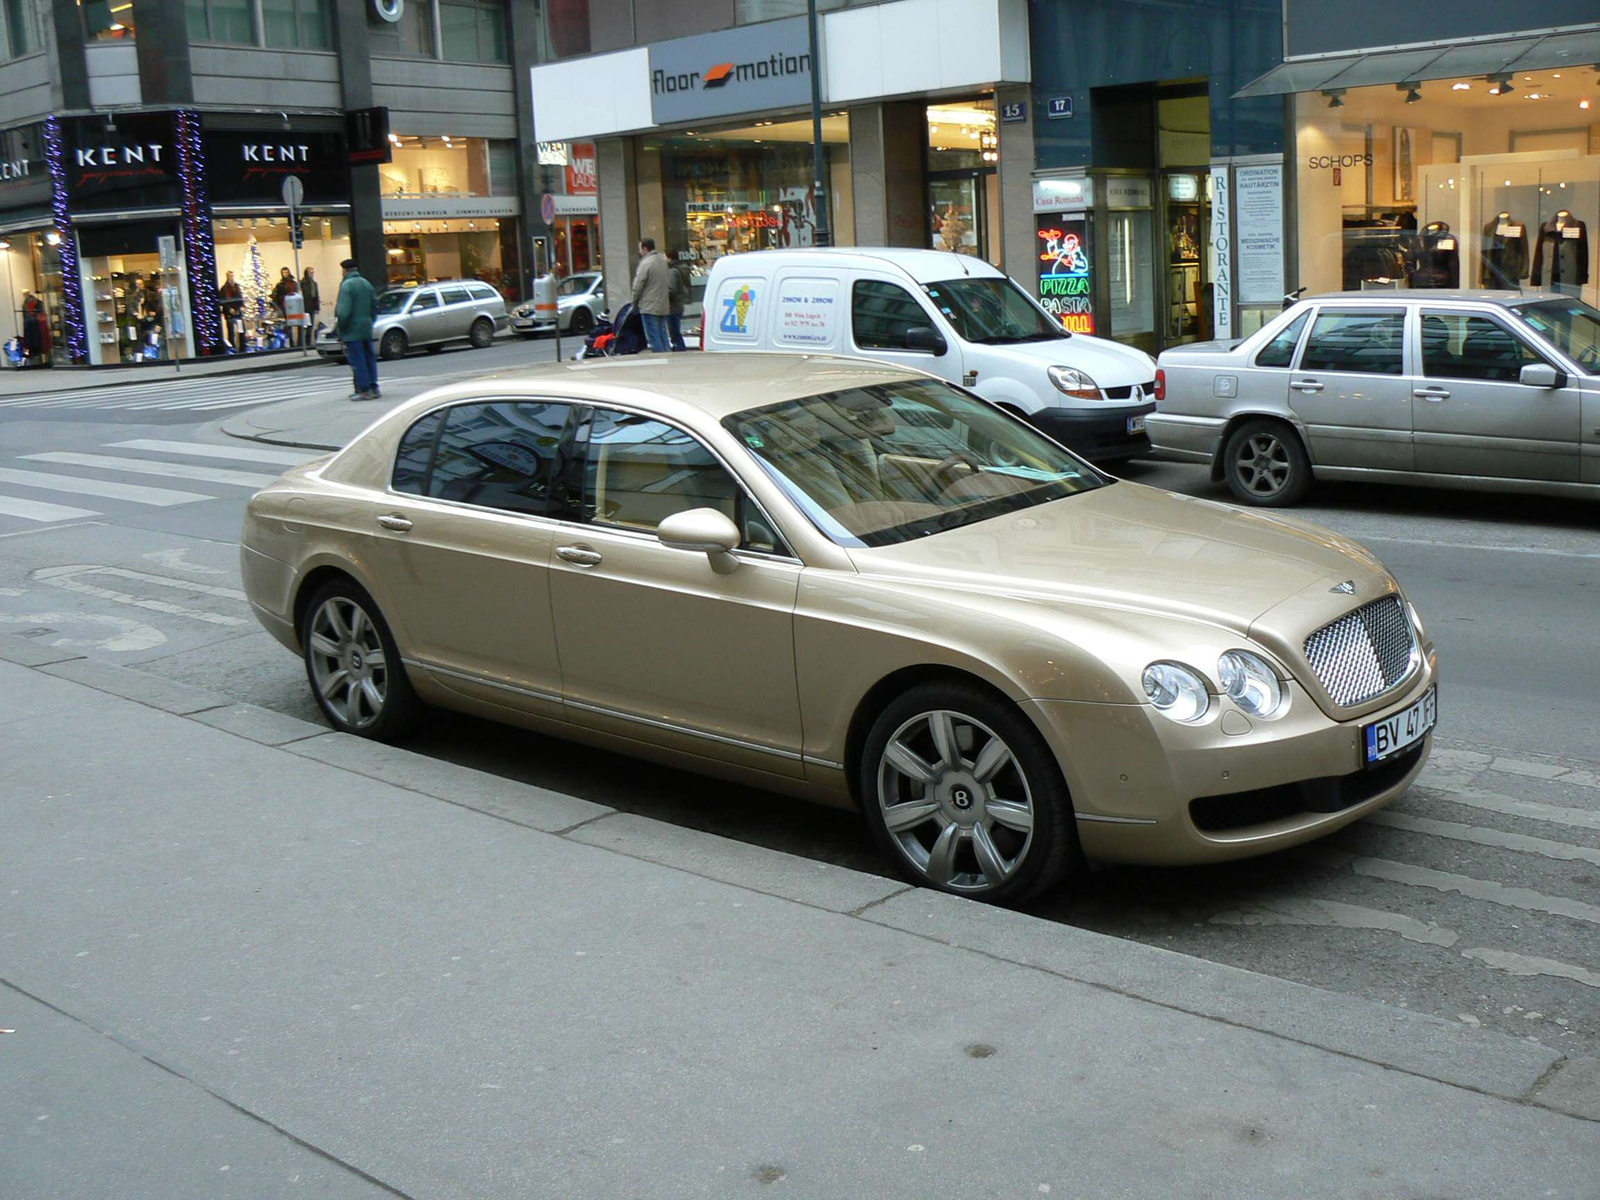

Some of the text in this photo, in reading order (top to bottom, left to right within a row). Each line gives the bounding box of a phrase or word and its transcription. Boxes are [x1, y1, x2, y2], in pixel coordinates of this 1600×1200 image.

[652, 52, 811, 94] floor motion
[1004, 104, 1020, 117] 15
[1054, 100, 1065, 111] 17
[77, 144, 162, 167] KENT
[243, 145, 308, 162] KENT
[539, 142, 566, 152] WELT
[1036, 196, 1084, 206] Casa Romana
[1215, 176, 1228, 326] RISTORANTE
[1040, 278, 1090, 295] PIZZA
[1040, 297, 1092, 314] PASTA
[1376, 719, 1399, 753] BV
[1406, 705, 1420, 738] 47
